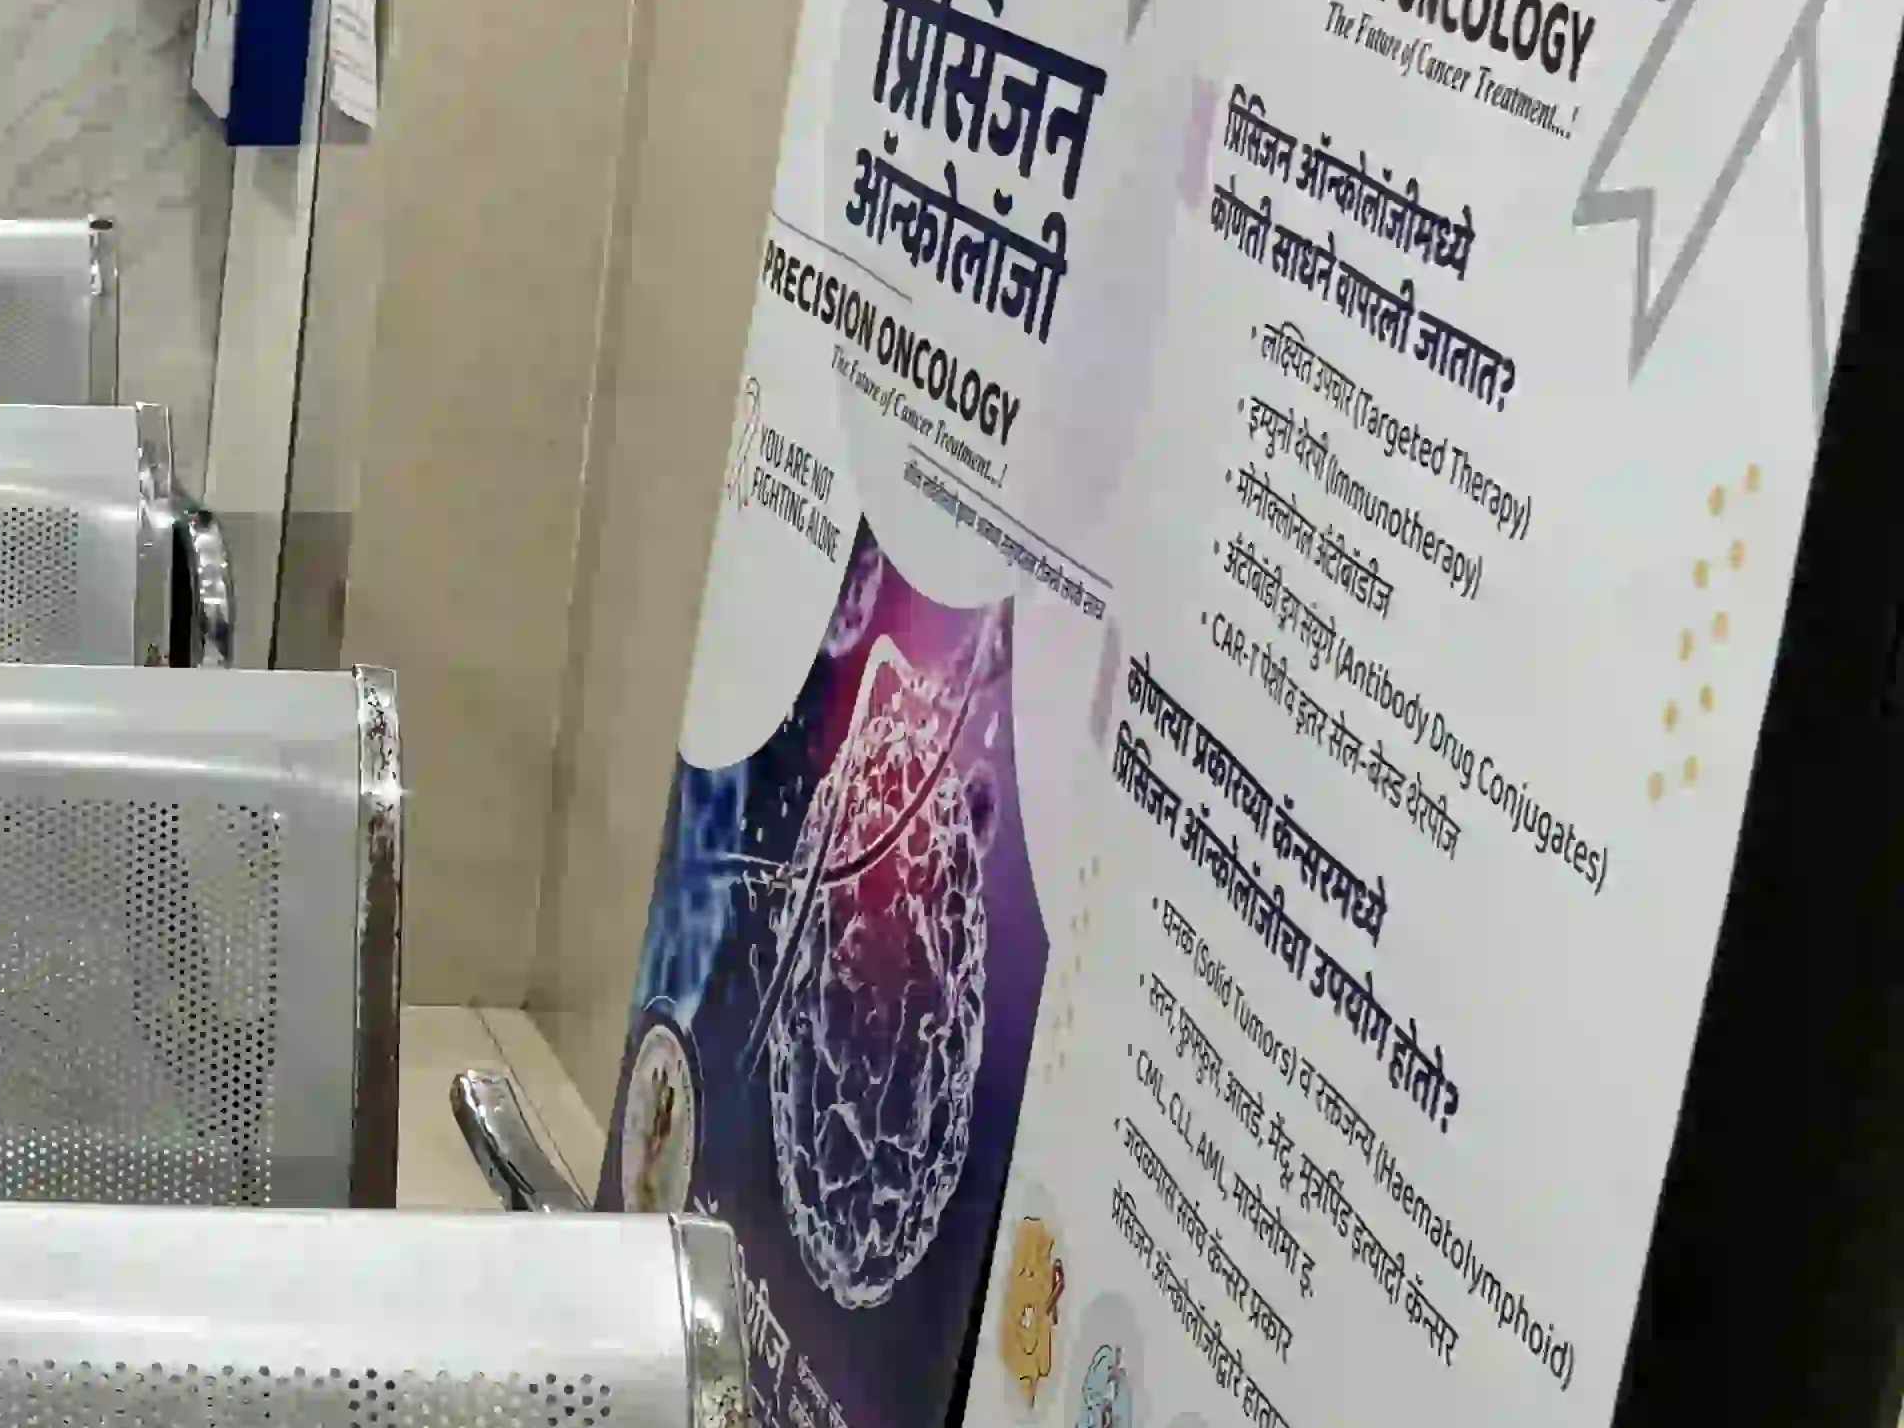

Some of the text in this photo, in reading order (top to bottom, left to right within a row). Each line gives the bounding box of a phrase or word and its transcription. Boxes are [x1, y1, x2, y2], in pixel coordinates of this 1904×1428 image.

[1324, 0, 1356, 43] The
[1355, 11, 1403, 63] Future
[1399, 34, 1420, 77] of
[1416, 40, 1472, 91] Cancer
[844, 127, 1069, 345] ऑन्कोलॉजी
[761, 238, 1021, 448] PRECISION ONCOLOGY
[750, 465, 809, 534] FIGHTING
[759, 423, 836, 505] YOU ARE NOT
[1449, 446, 1533, 542] Therapy)
[1211, 611, 1261, 678] CAR-T
[1334, 635, 1430, 746] (Antibody
[1429, 711, 1476, 791] Drug
